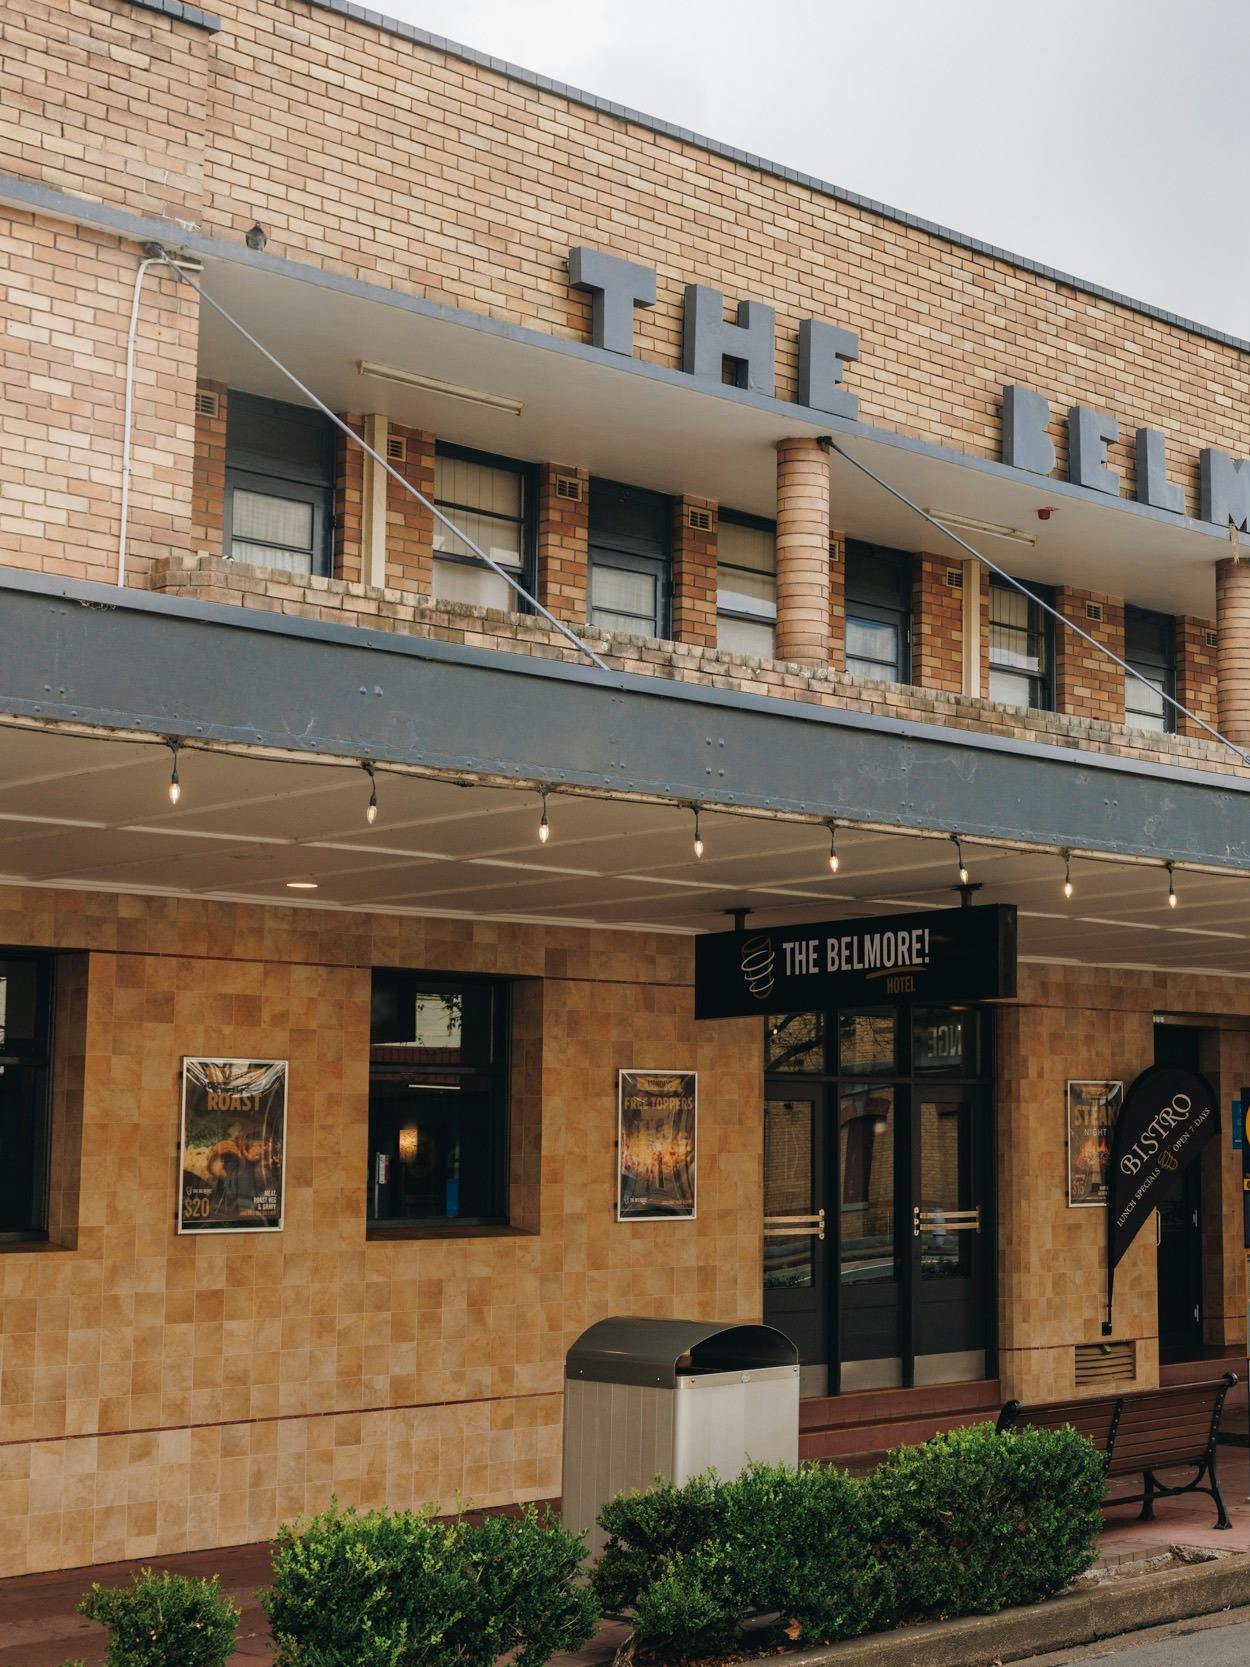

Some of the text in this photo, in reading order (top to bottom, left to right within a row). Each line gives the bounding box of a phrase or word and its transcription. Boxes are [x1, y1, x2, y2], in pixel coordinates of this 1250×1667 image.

[567, 247, 860, 422] THE
[782, 928, 930, 976] THE BELMORE!
[886, 976, 916, 995] HOTEL
[207, 1091, 263, 1111] ROAST
[1084, 1128, 1108, 1136] NIGHT
[1120, 1093, 1192, 1176] BISTRO
[1172, 1107, 1212, 1152] OPEN 7 DAYS
[184, 1198, 210, 1217] $20
[1116, 1167, 1161, 1228] LUNCH SPECIALS
